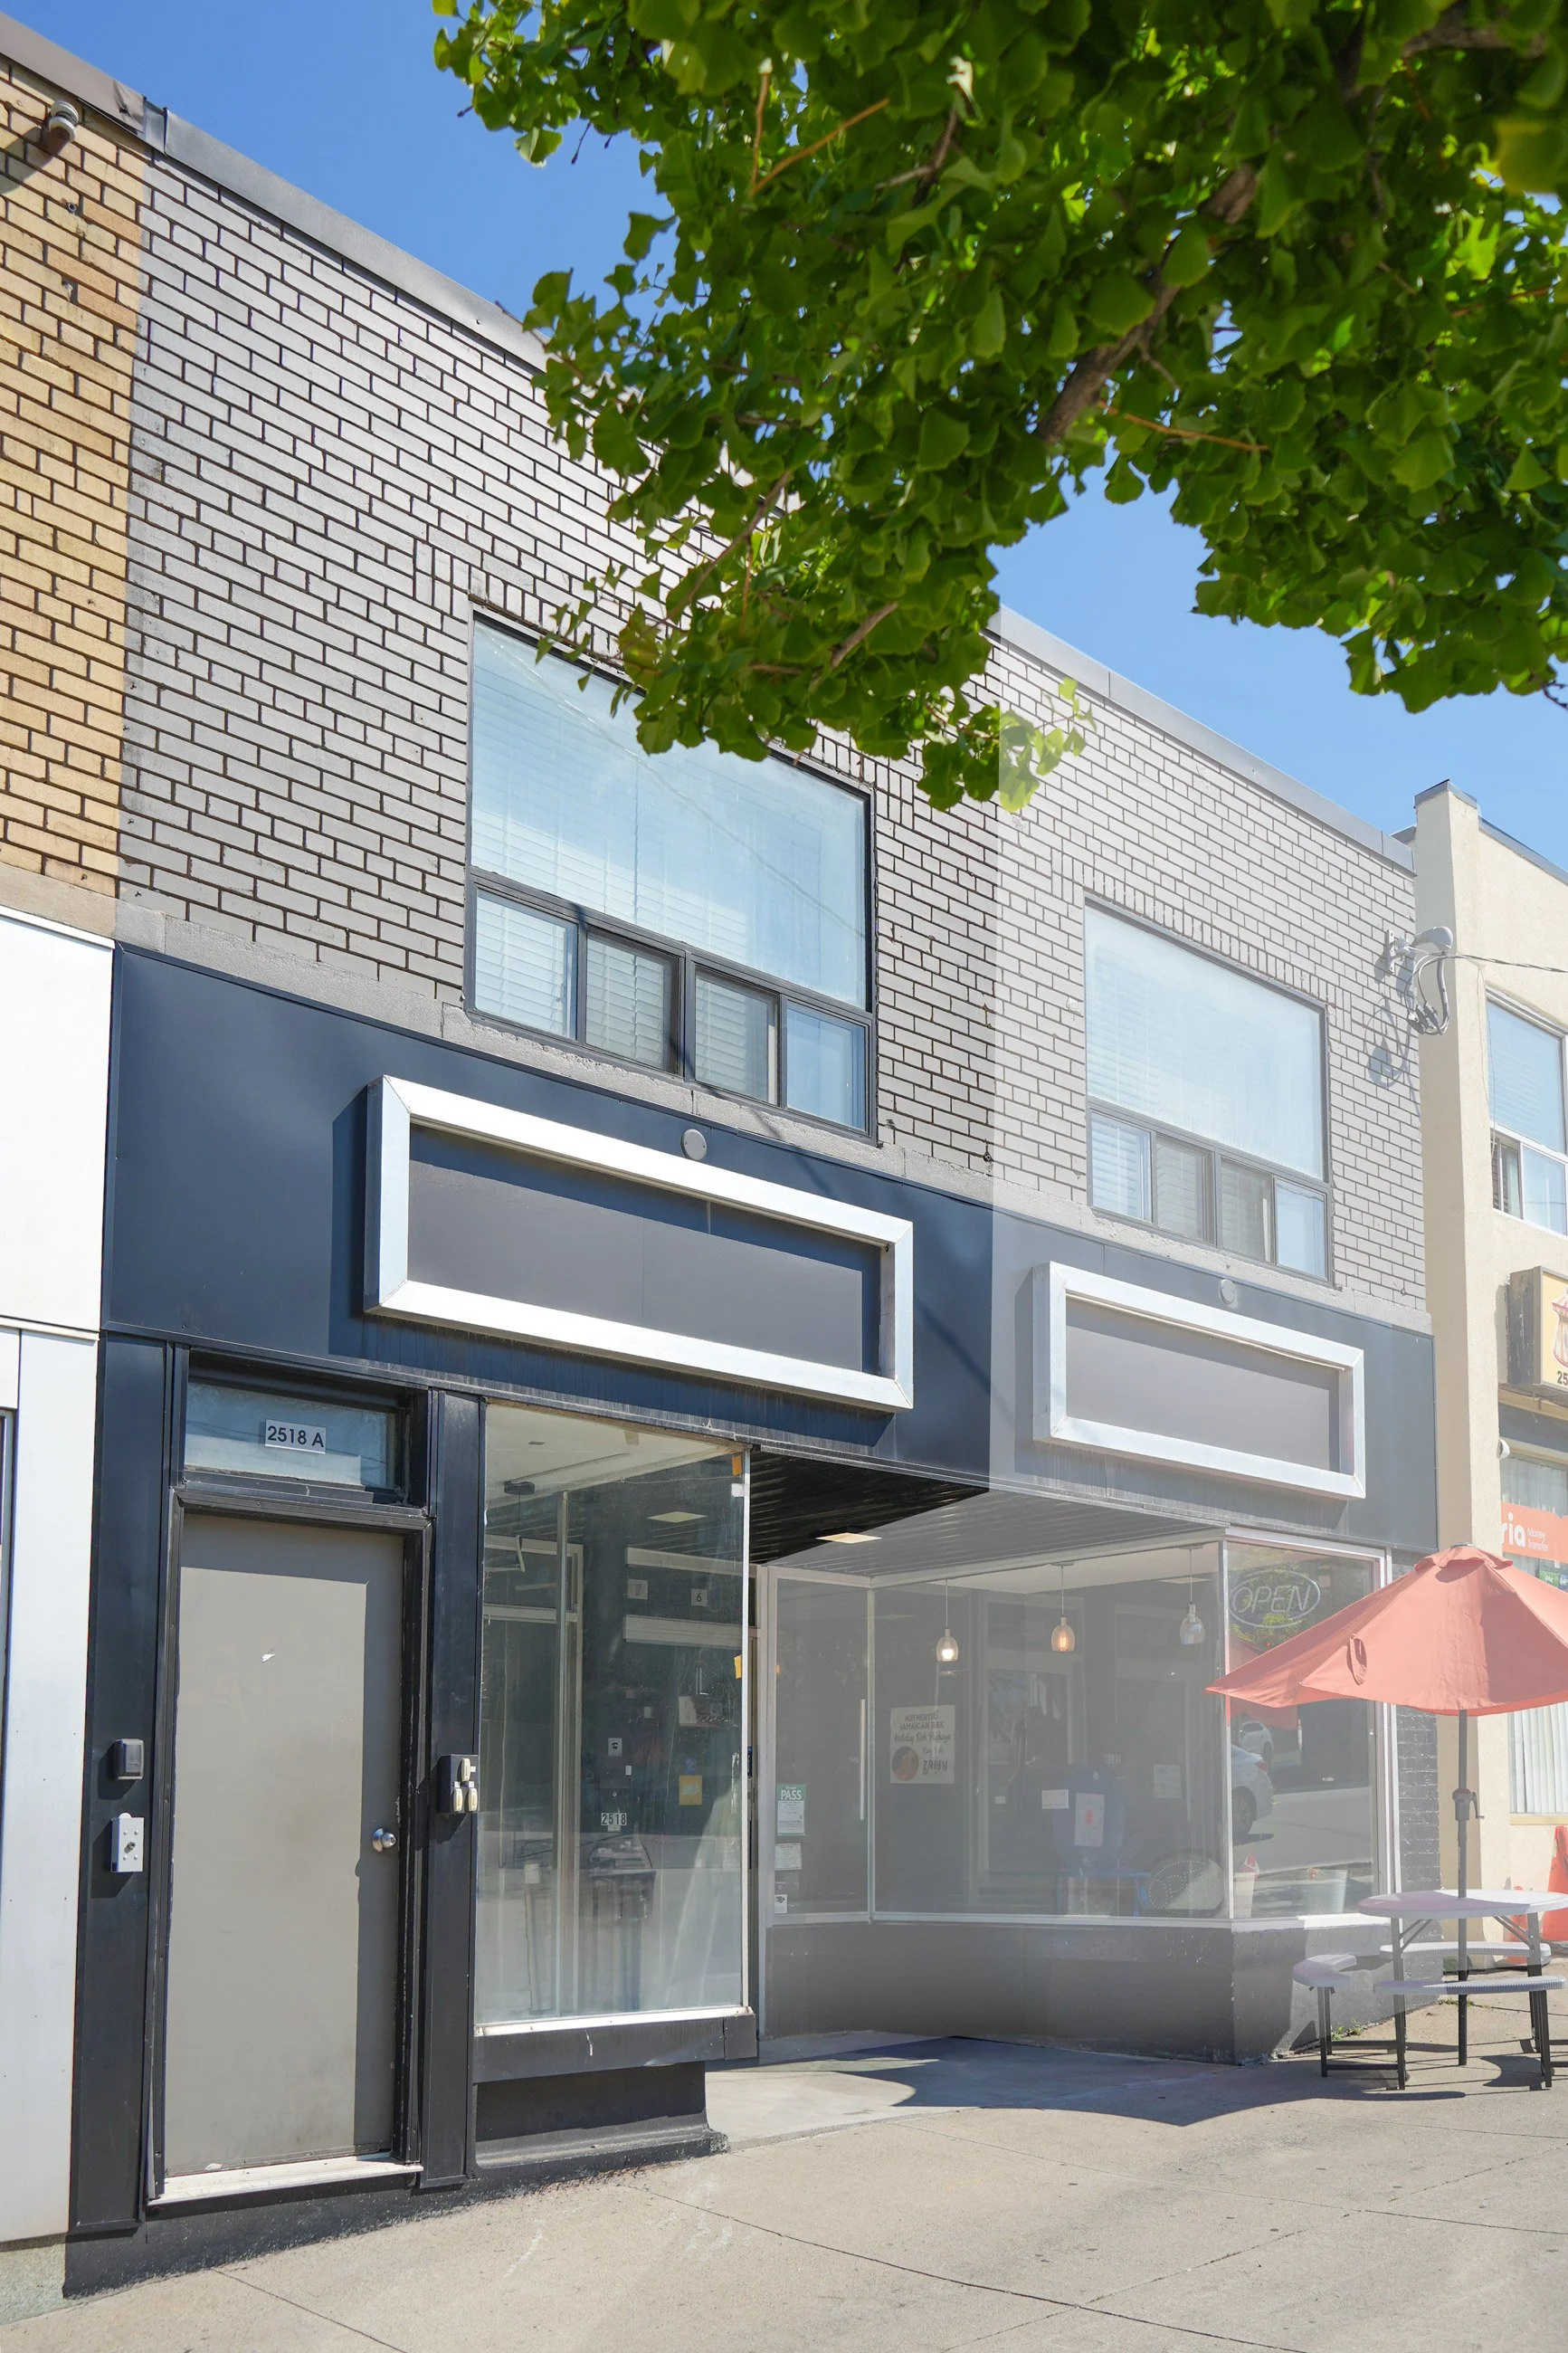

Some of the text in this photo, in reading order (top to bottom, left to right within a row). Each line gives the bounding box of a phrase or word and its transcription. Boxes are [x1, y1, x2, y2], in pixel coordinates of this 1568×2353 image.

[268, 1425, 324, 1448] 2518 A
[1527, 1527, 1546, 1542] Money
[1527, 1538, 1549, 1551] Transfer
[696, 1592, 702, 1603] 6
[1232, 1585, 1311, 1614] OPEN
[780, 1789, 803, 1800] PASS
[602, 1813, 626, 1825] 2518
